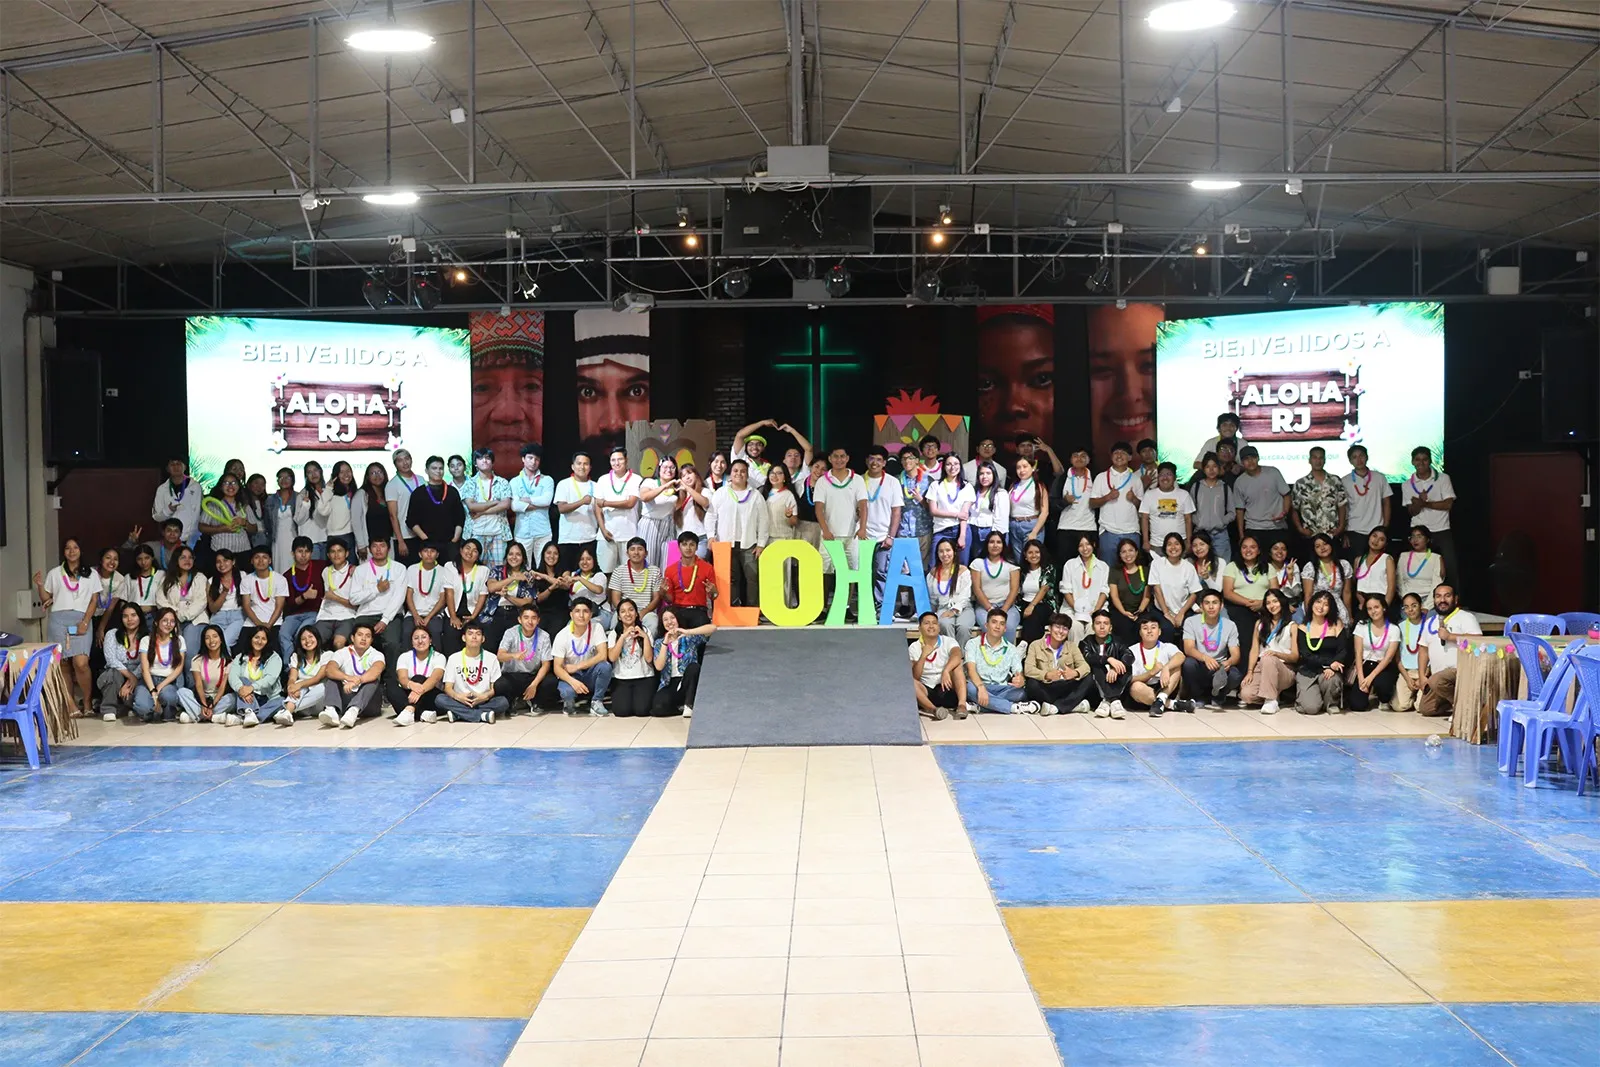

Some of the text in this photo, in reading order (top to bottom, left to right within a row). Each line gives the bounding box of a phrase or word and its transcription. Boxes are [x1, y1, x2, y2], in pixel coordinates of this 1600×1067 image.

[241, 343, 428, 367] BIENVENIDOS A
[1203, 329, 1391, 358] BIENVENIDOS A
[285, 391, 388, 415] ALOHA
[1240, 380, 1345, 406] ALOHA
[317, 417, 357, 442] RJ
[1271, 406, 1311, 433] RJ
